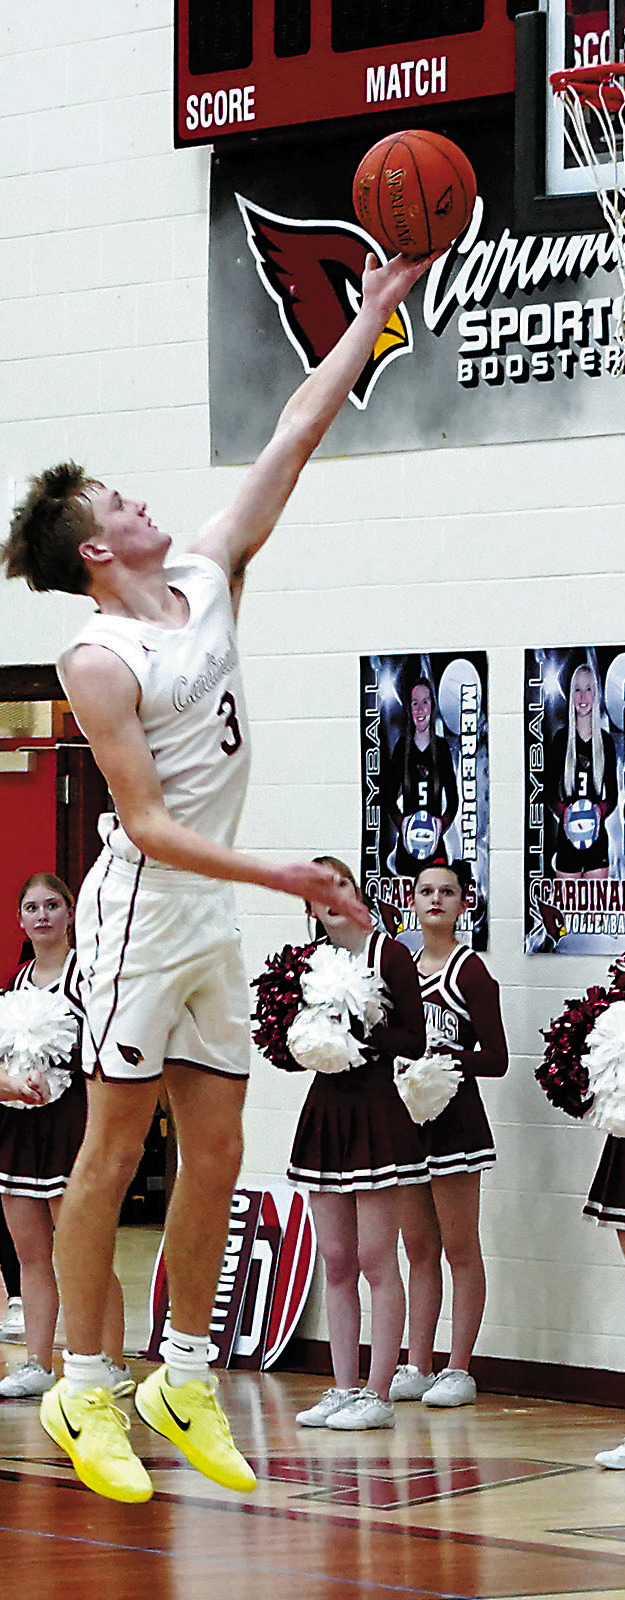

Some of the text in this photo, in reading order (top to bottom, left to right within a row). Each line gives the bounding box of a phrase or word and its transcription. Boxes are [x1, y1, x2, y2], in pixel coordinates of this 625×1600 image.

[366, 56, 447, 103] MATCH
[186, 86, 256, 131] SCORE
[217, 691, 242, 757] 3
[418, 781, 428, 806] 5
[461, 684, 478, 862] MEREDITH
[578, 772, 588, 796] 3
